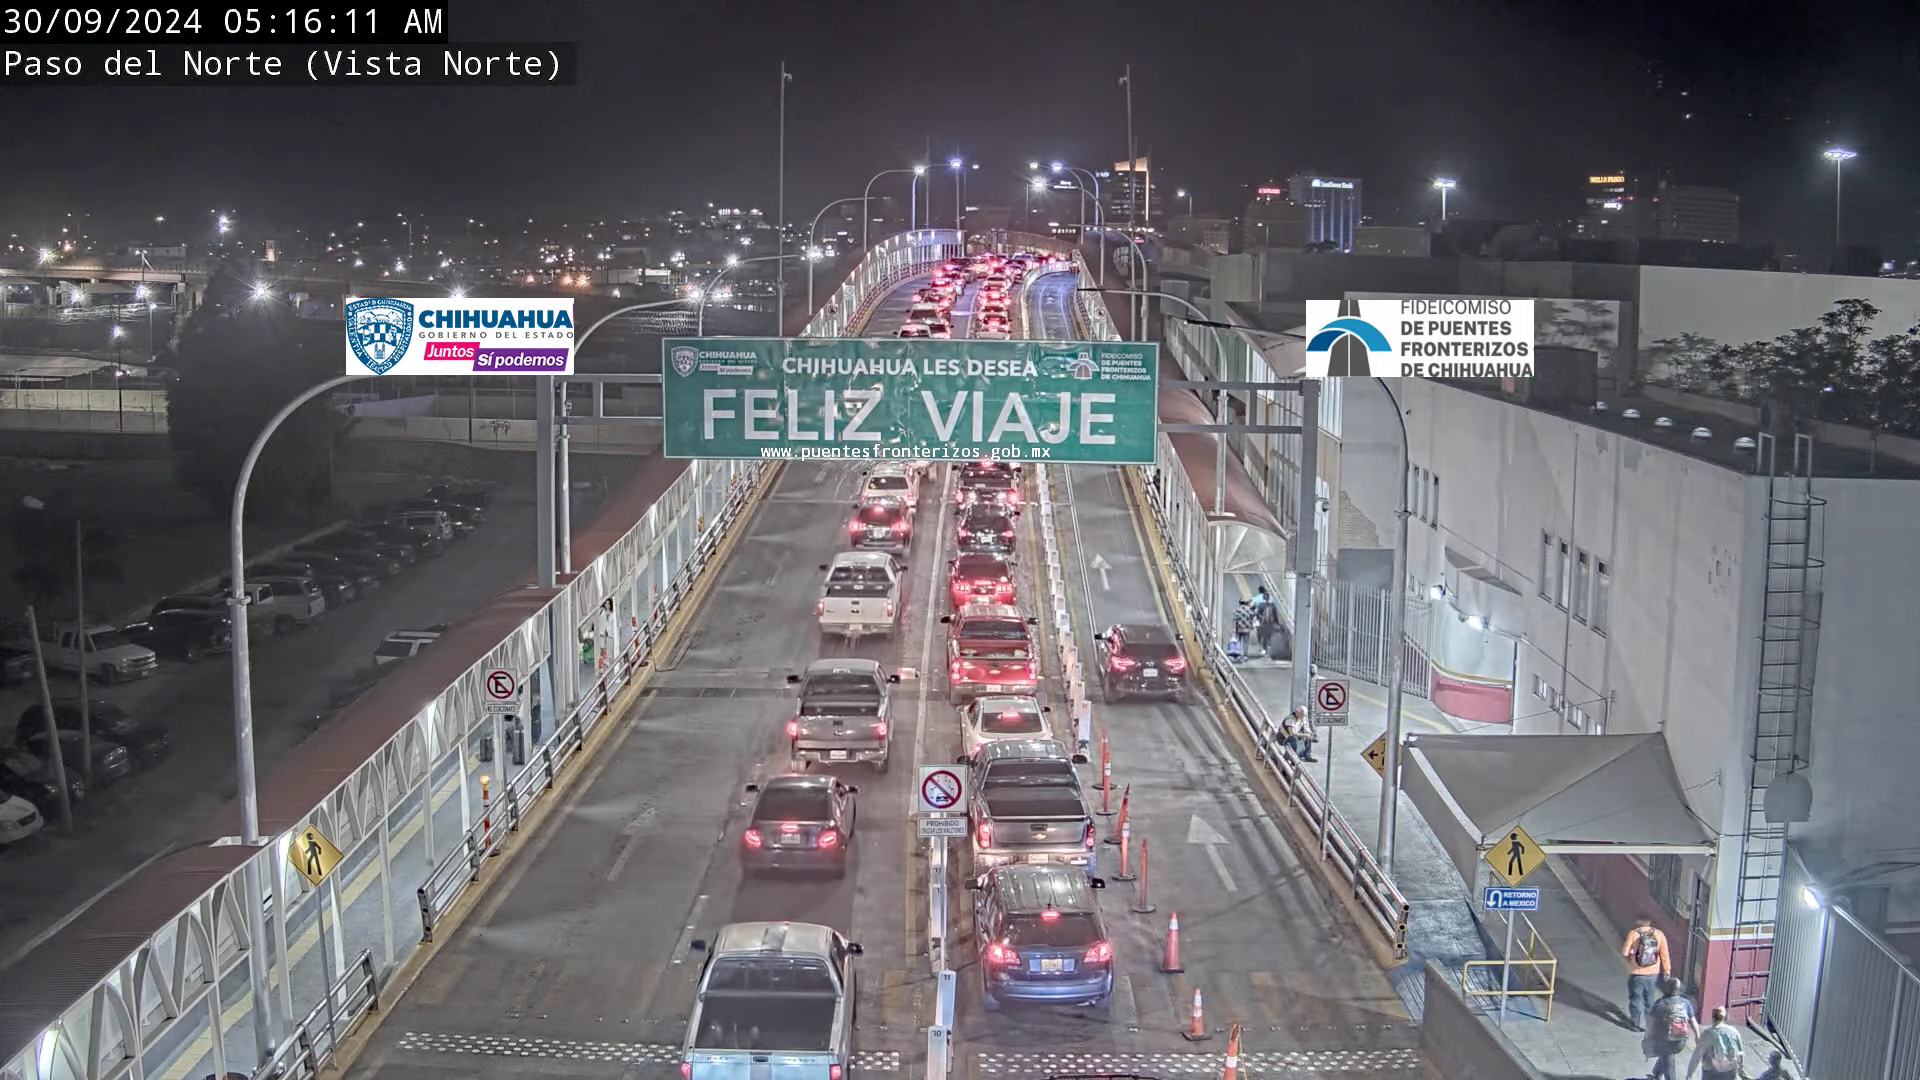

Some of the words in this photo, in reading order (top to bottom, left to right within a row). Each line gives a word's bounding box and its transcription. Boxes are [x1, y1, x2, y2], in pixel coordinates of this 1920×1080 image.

[699, 351, 757, 359] CHIHUAHUA
[782, 357, 917, 376] CHIHUAHUA
[923, 359, 960, 375] LES
[967, 360, 1038, 377] DESEA
[703, 389, 882, 440] FELIZ
[921, 390, 1116, 444] VIAJE
